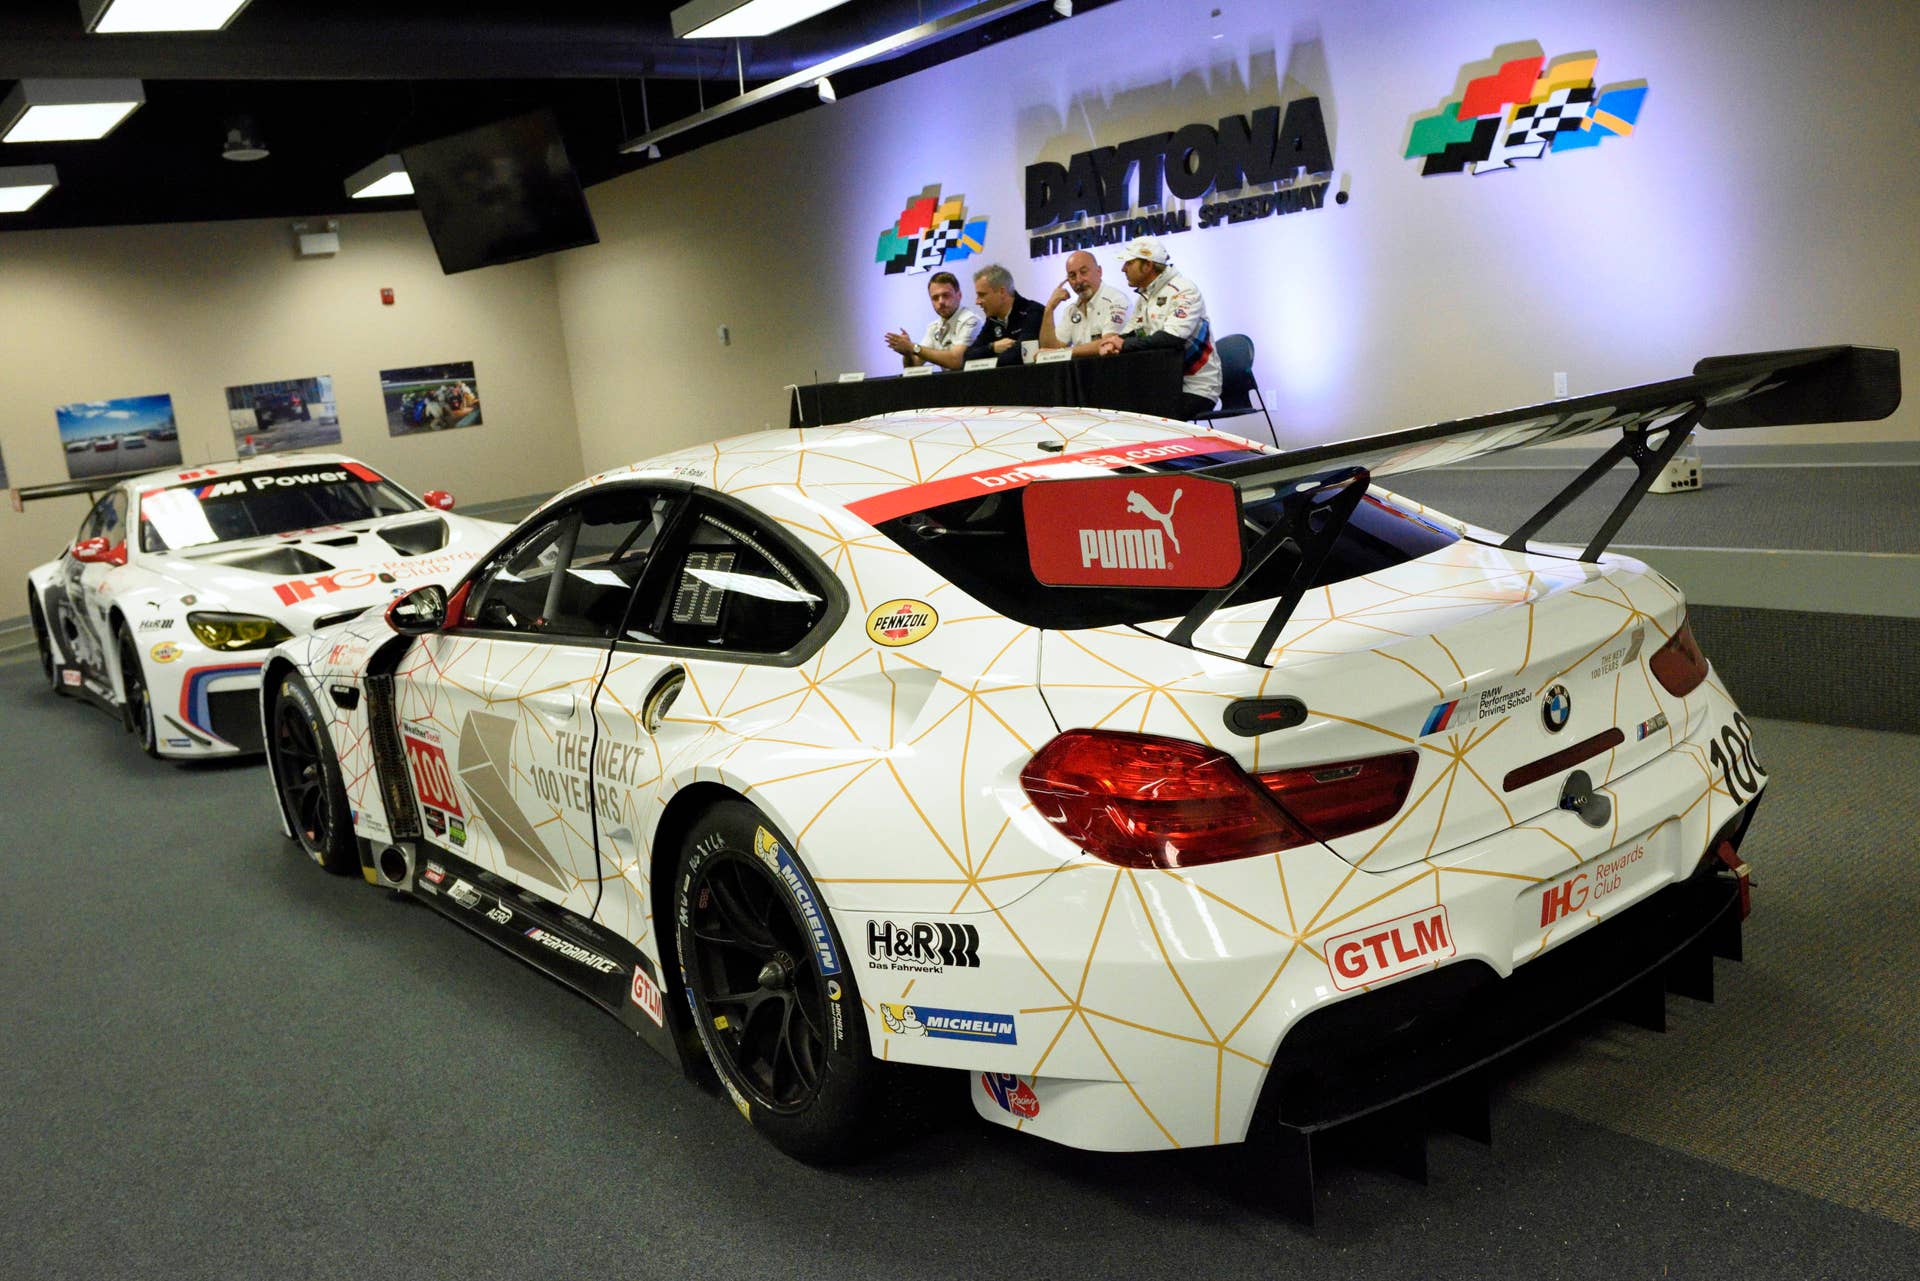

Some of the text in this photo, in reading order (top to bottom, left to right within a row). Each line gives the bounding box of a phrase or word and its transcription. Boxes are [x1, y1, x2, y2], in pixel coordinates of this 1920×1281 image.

[1025, 97, 1333, 231] DAYTONA
[1030, 181, 1331, 259] INTERNATIONAL SPEEDWAY
[252, 468, 348, 491] Power
[971, 443, 1195, 488] bmsa.com
[1079, 528, 1166, 570] PUMA
[272, 568, 376, 606] IHG
[873, 613, 929, 631] PENNZOIL
[1479, 688, 1527, 709] Performance
[1479, 705, 1506, 719] Driving
[1507, 692, 1532, 709] School
[1480, 686, 1503, 700] BMW
[403, 723, 441, 742] WeatherTech
[411, 746, 457, 809] 100
[556, 730, 645, 786] THE NEXT
[1710, 711, 1768, 807] 100
[530, 765, 622, 825] 100 YEARS
[1595, 844, 1645, 881] Rewards
[485, 906, 512, 925] AERO
[780, 863, 835, 970] MICHELIN
[1540, 873, 1622, 928] IHG Club
[540, 932, 617, 974] PERFORMANCE
[867, 919, 941, 966] H&R
[1333, 914, 1450, 979] GTLM
[869, 961, 889, 971] Das
[634, 974, 663, 1026] GTLM
[834, 1002, 844, 1041] MICHELIN
[926, 1015, 1013, 1035] MICHELIN
